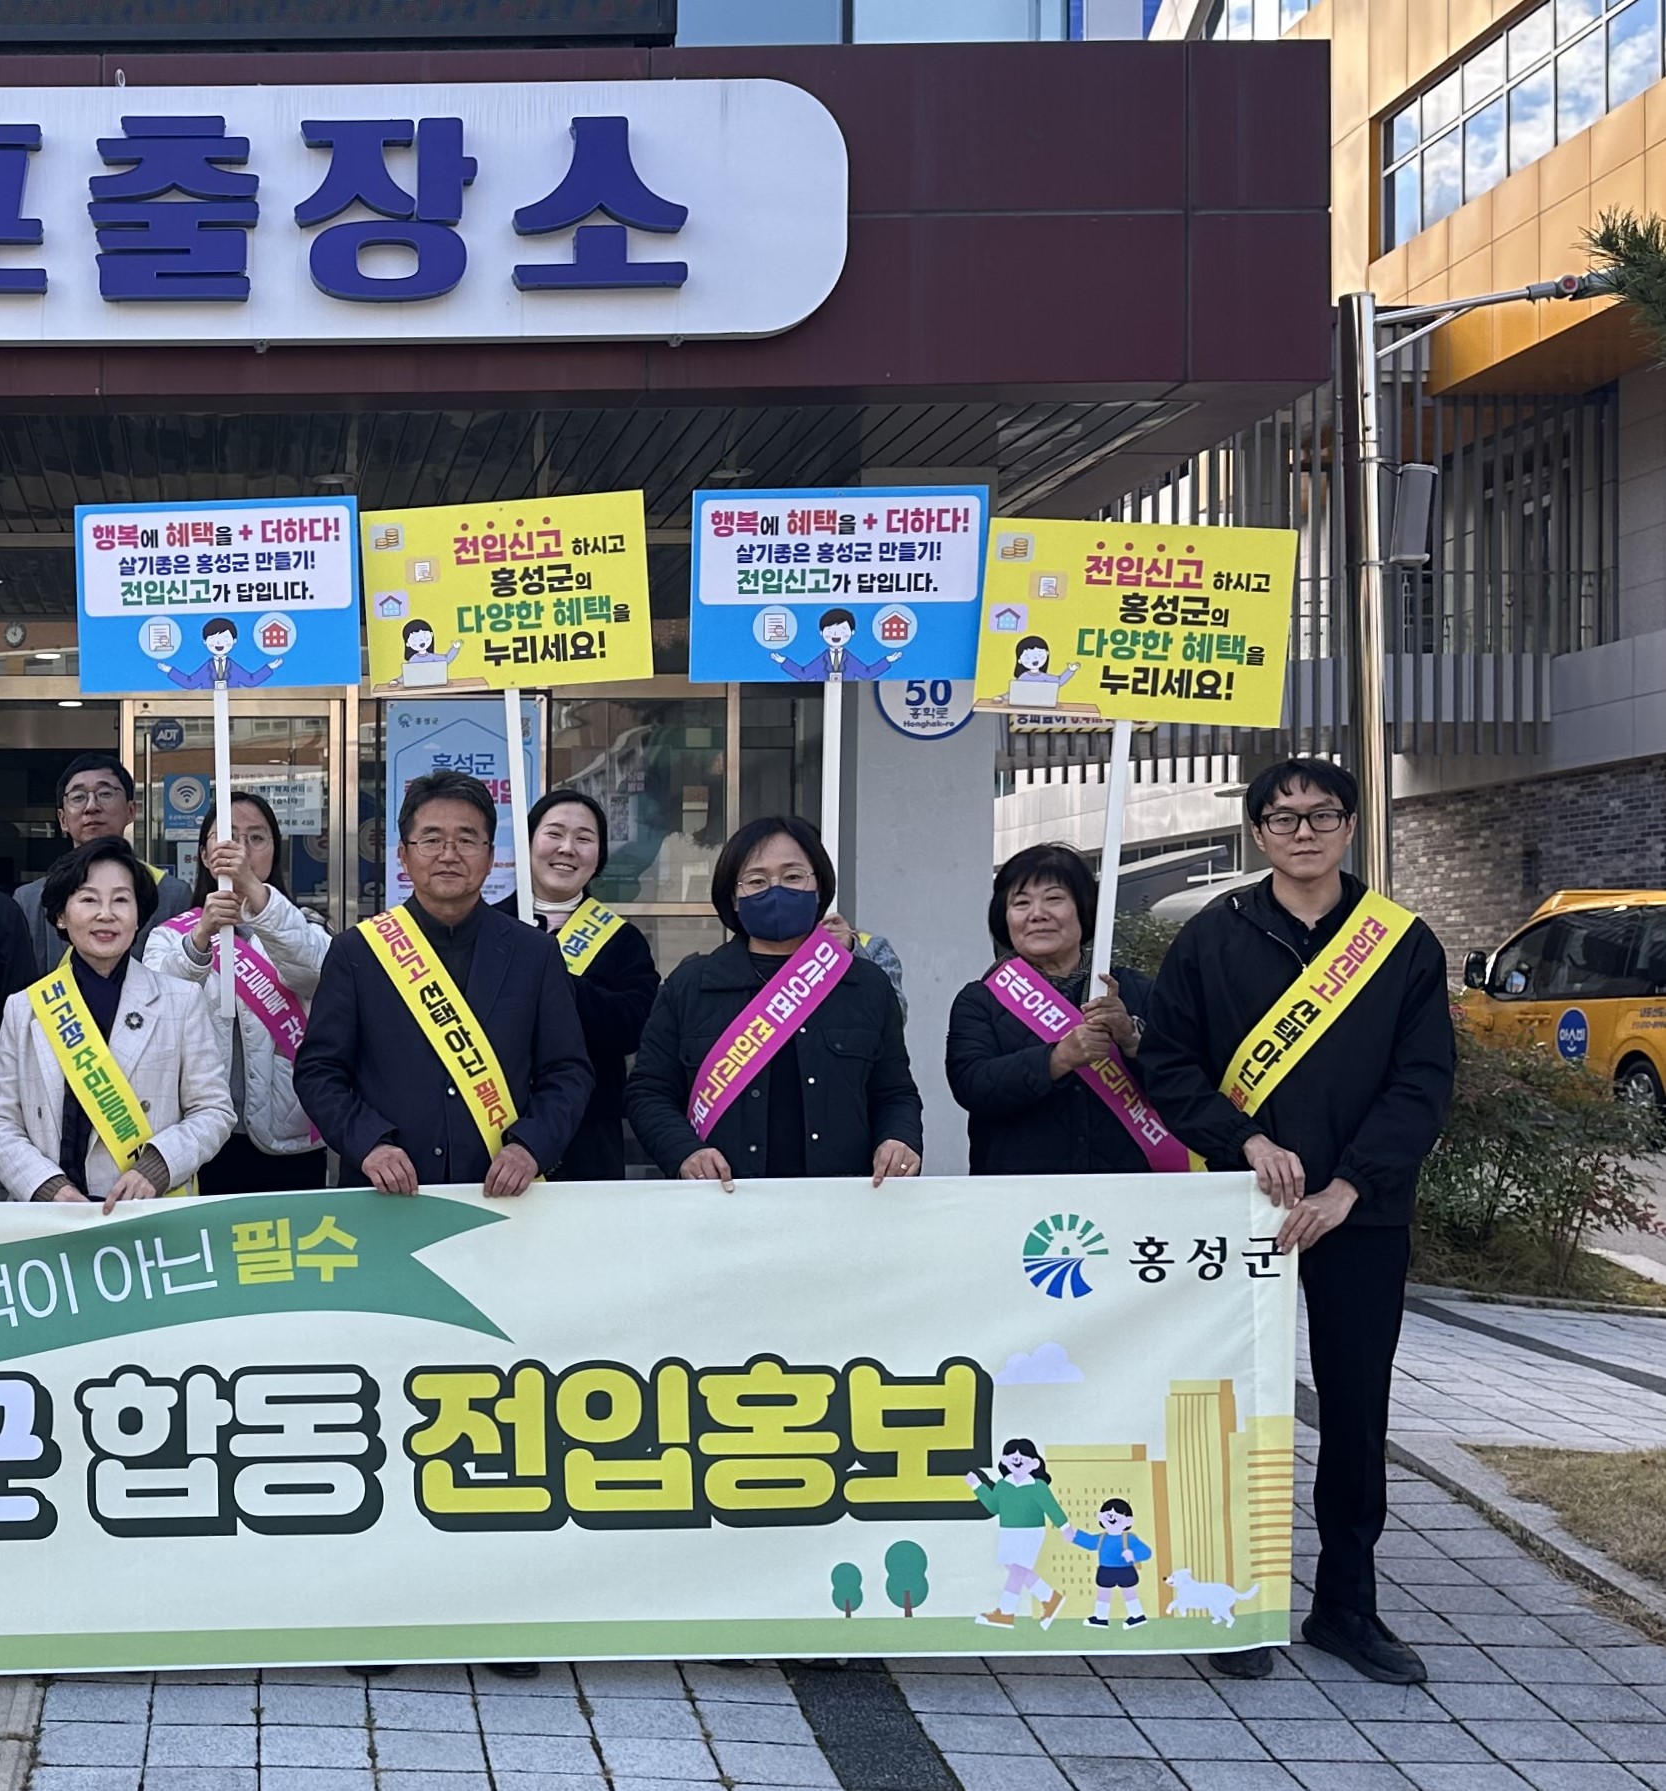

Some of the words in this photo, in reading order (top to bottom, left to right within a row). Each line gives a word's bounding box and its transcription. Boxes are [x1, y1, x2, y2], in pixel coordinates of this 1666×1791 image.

[93, 524, 159, 551] 행복에
[166, 522, 232, 547] 혜택을
[261, 517, 340, 544] 더하다!
[711, 510, 779, 538] 행복에
[787, 509, 856, 535] 혜택을
[886, 508, 970, 534] 더하다!
[119, 554, 190, 577] 살기좋은
[196, 552, 250, 574] 홍성군
[255, 550, 316, 571] 만들기!
[453, 529, 564, 566] 전입신고
[572, 534, 625, 556] 하시고
[736, 543, 811, 564] 살기좋은
[816, 542, 872, 563] 홍성군
[878, 541, 942, 562] 만들기!
[490, 563, 592, 598] 홍성군의
[737, 568, 851, 595] 전입신고가
[857, 573, 938, 593] 답입니다.
[1084, 555, 1203, 589] 전입신고
[1213, 571, 1271, 593] 하시고
[121, 579, 230, 607] 전입신고가
[236, 581, 314, 602] 답입니다.
[1119, 592, 1229, 628] 홍성군의
[457, 600, 544, 634] 다양한
[553, 595, 631, 626] 혜택을
[484, 631, 606, 666] 누리세요!
[1076, 628, 1173, 661] 다양한
[1182, 631, 1265, 666] 혜택을
[905, 679, 952, 706] 50
[1099, 666, 1234, 701] 누리세요!
[903, 720, 955, 729] Honghak-ro
[909, 707, 948, 719] 홍학로
[156, 729, 179, 741] ADT
[431, 753, 495, 775] 홍성군
[590, 905, 614, 925] 내
[562, 920, 601, 958] 고장
[1310, 916, 1388, 1004] 전입신고
[42, 980, 66, 1006] 내
[766, 941, 839, 1024] 이사오면
[51, 1002, 85, 1049] 고장
[995, 965, 1070, 1032] 이사오면
[1082, 1048, 1169, 1146] 신고부터
[72, 1045, 140, 1144] 주민등록
[473, 1078, 509, 1130] 필수
[93, 1228, 218, 1305] 아닌
[231, 1216, 358, 1287] 필수
[1129, 1236, 1285, 1283] 홍성군
[78, 1367, 378, 1532] 합동
[406, 1357, 989, 1526] 전입홍보
